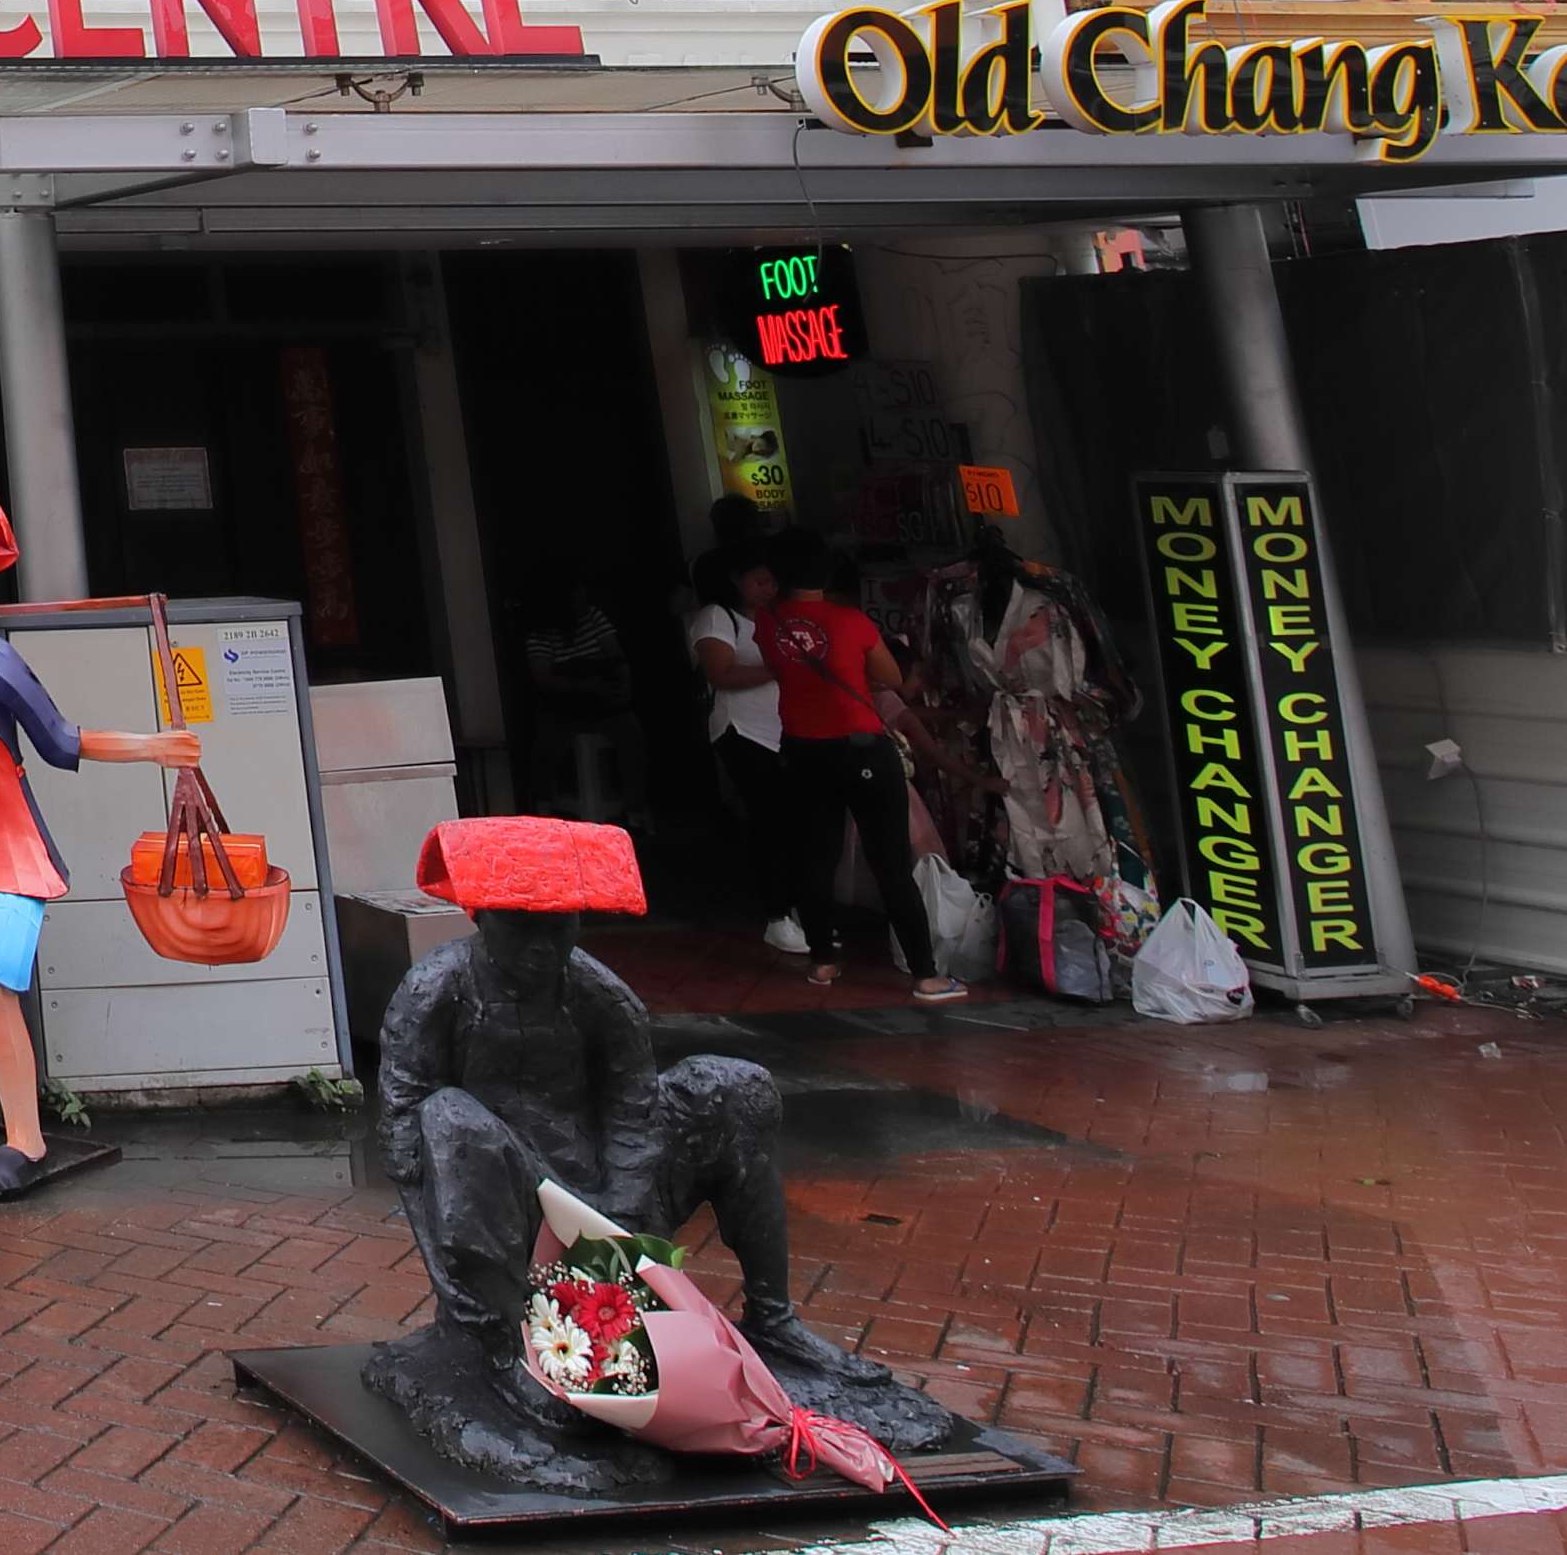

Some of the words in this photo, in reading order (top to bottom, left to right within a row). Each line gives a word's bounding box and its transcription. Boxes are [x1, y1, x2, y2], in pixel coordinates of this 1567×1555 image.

[760, 255, 819, 301] FOOT
[756, 304, 849, 365] MASSAGE
[717, 390, 771, 401] MASSAGE
[739, 379, 767, 390] FOOT
[751, 465, 784, 486] $30
[755, 489, 786, 500] BODY
[966, 483, 1005, 512] $10
[1149, 495, 1230, 671] MONEY
[1246, 495, 1320, 673] MONEY
[1179, 688, 1273, 952] CHANGER
[1277, 692, 1364, 953] CHANGER
